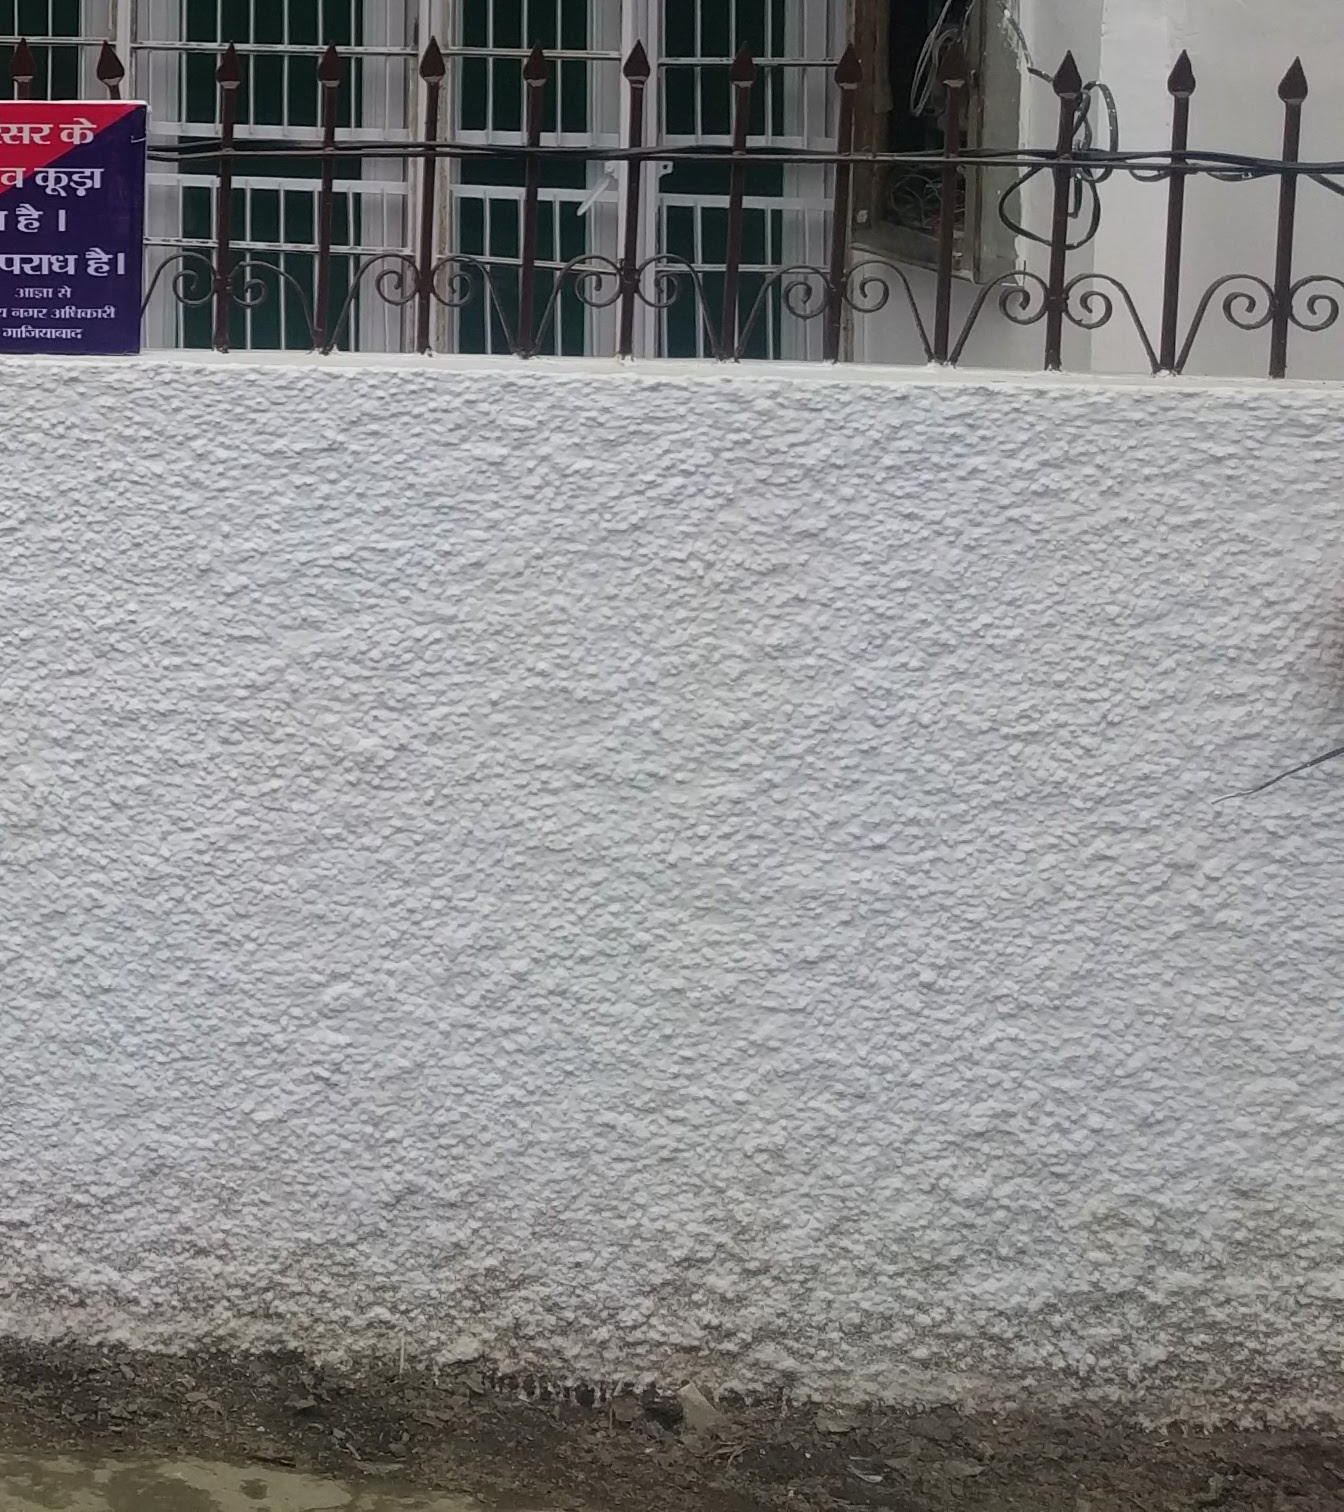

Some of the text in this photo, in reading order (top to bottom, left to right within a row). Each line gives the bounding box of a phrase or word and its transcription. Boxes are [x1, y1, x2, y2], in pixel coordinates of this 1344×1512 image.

[59, 118, 97, 144] के
[34, 168, 104, 196] कूड़ा
[16, 204, 43, 232] है
